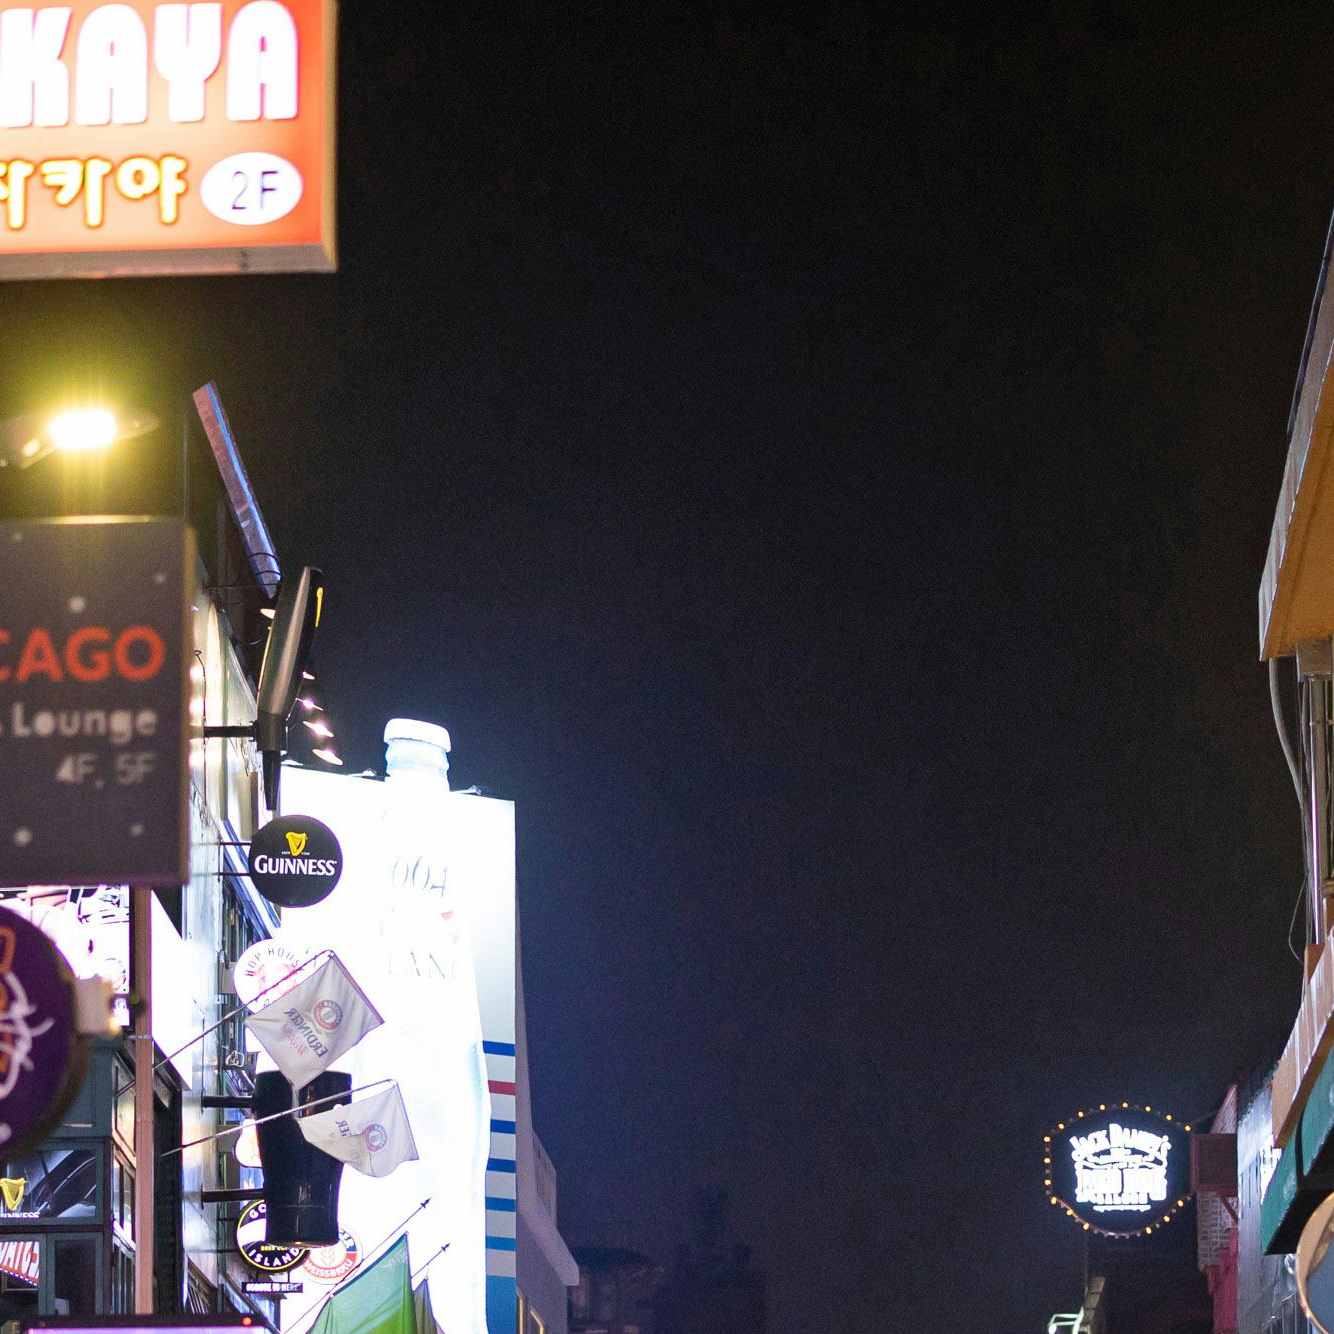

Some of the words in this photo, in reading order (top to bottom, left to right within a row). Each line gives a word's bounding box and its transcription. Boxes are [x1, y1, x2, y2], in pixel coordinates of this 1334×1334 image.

[230, 170, 279, 210] 2F
[12, 702, 157, 744] Lounge
[254, 854, 337, 876] GUINNESS
[244, 952, 262, 977] HOP
[248, 1247, 301, 1267] ISLAND
